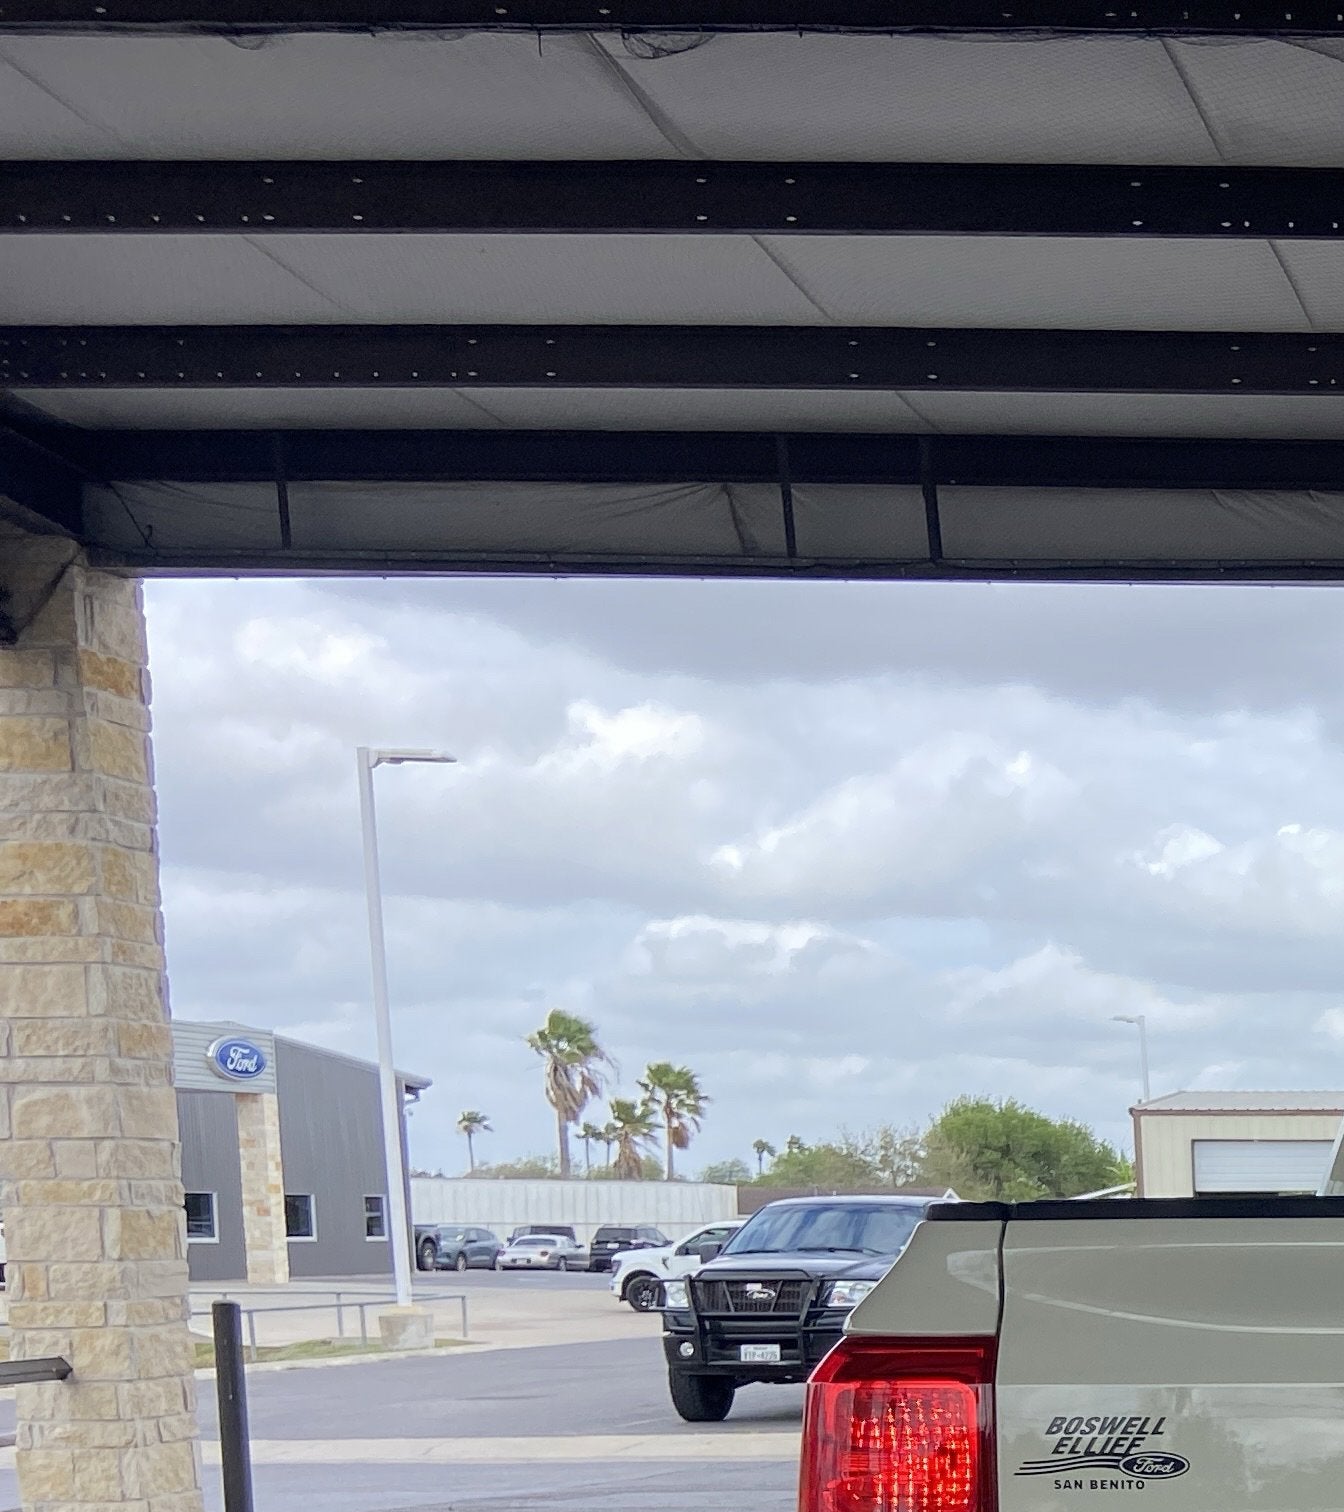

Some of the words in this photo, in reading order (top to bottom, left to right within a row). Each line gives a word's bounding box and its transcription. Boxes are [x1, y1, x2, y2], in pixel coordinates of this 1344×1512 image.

[226, 1046, 258, 1072] Ford
[1045, 1417, 1166, 1435] BOSWELL
[1051, 1437, 1146, 1456] ELLIFF
[1133, 1457, 1174, 1474] Ford
[1054, 1480, 1083, 1490] SAN
[1090, 1480, 1145, 1490] BENITO
